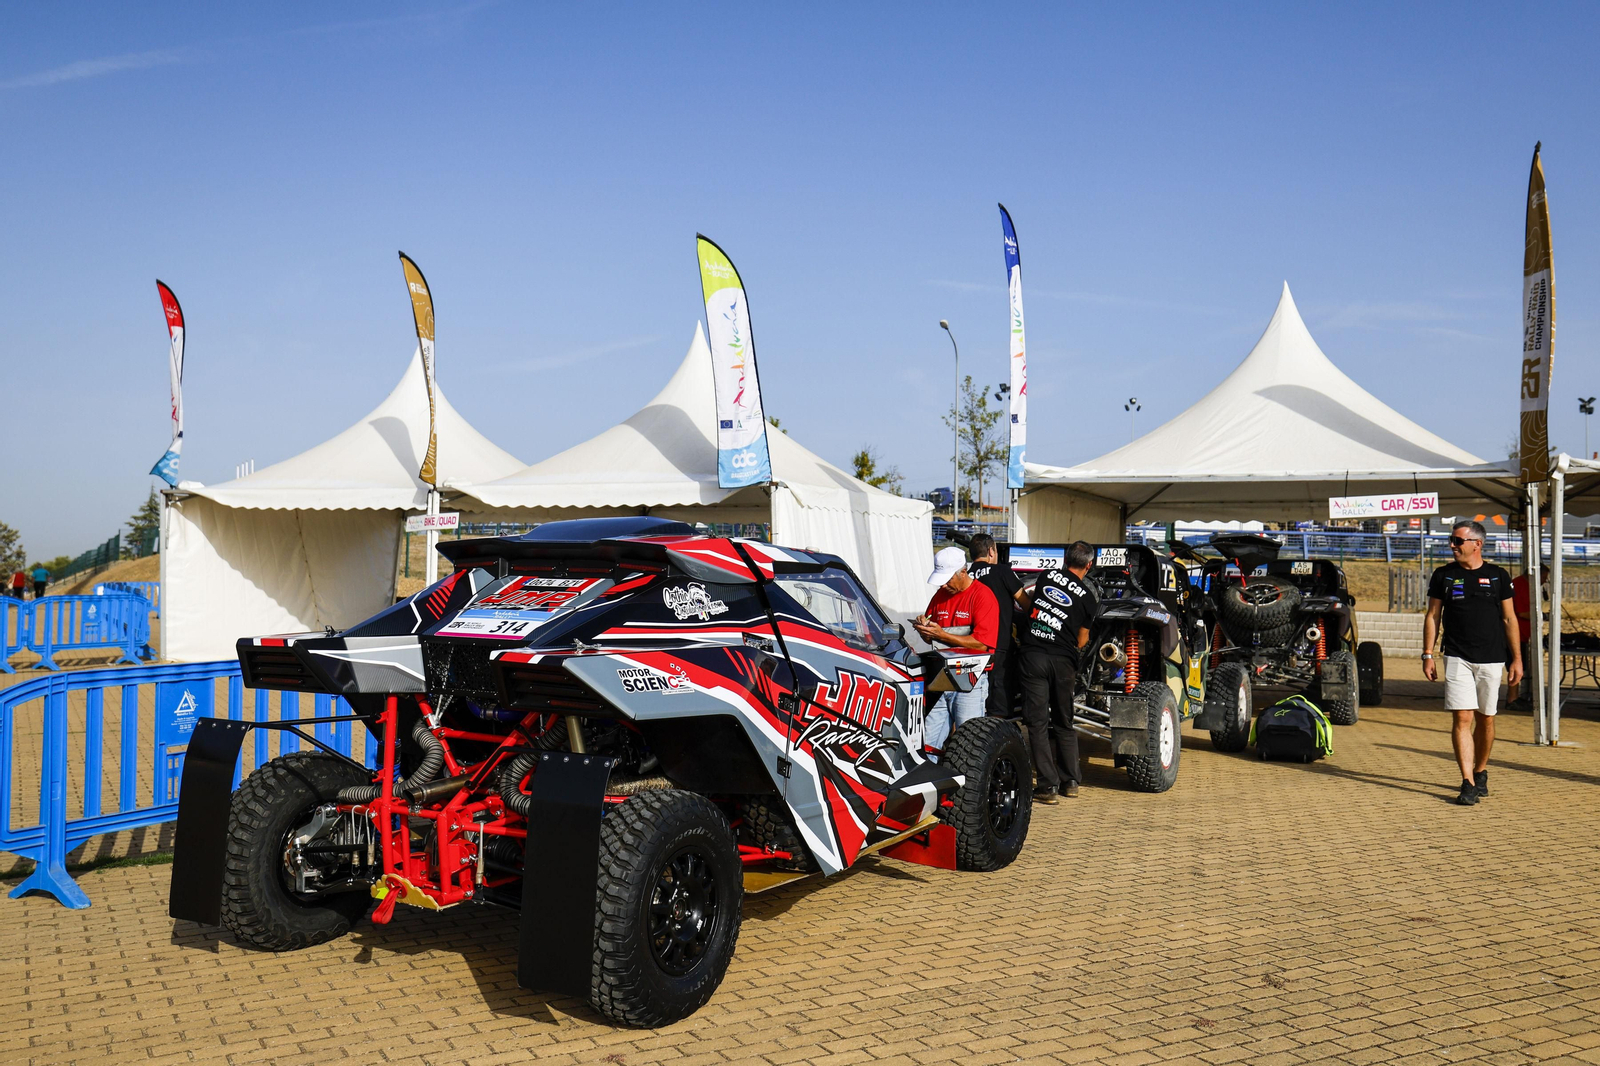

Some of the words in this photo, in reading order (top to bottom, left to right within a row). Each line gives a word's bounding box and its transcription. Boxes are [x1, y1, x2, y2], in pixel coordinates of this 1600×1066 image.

[1528, 282, 1539, 351] RALLY-RAID
[1342, 508, 1367, 516] RALLY
[1381, 499, 1405, 511] CAR
[424, 517, 436, 526] BIKE
[1037, 559, 1057, 569] 322
[975, 566, 991, 580] Car
[1047, 570, 1069, 586] SGS
[1067, 581, 1087, 597] Car
[478, 590, 579, 606] JMP
[1048, 589, 1067, 603] Ford
[488, 620, 530, 634] 314
[618, 668, 651, 678] MOTOR
[804, 666, 897, 737] JMP
[908, 697, 923, 735] 314
[793, 714, 900, 767] Racing
